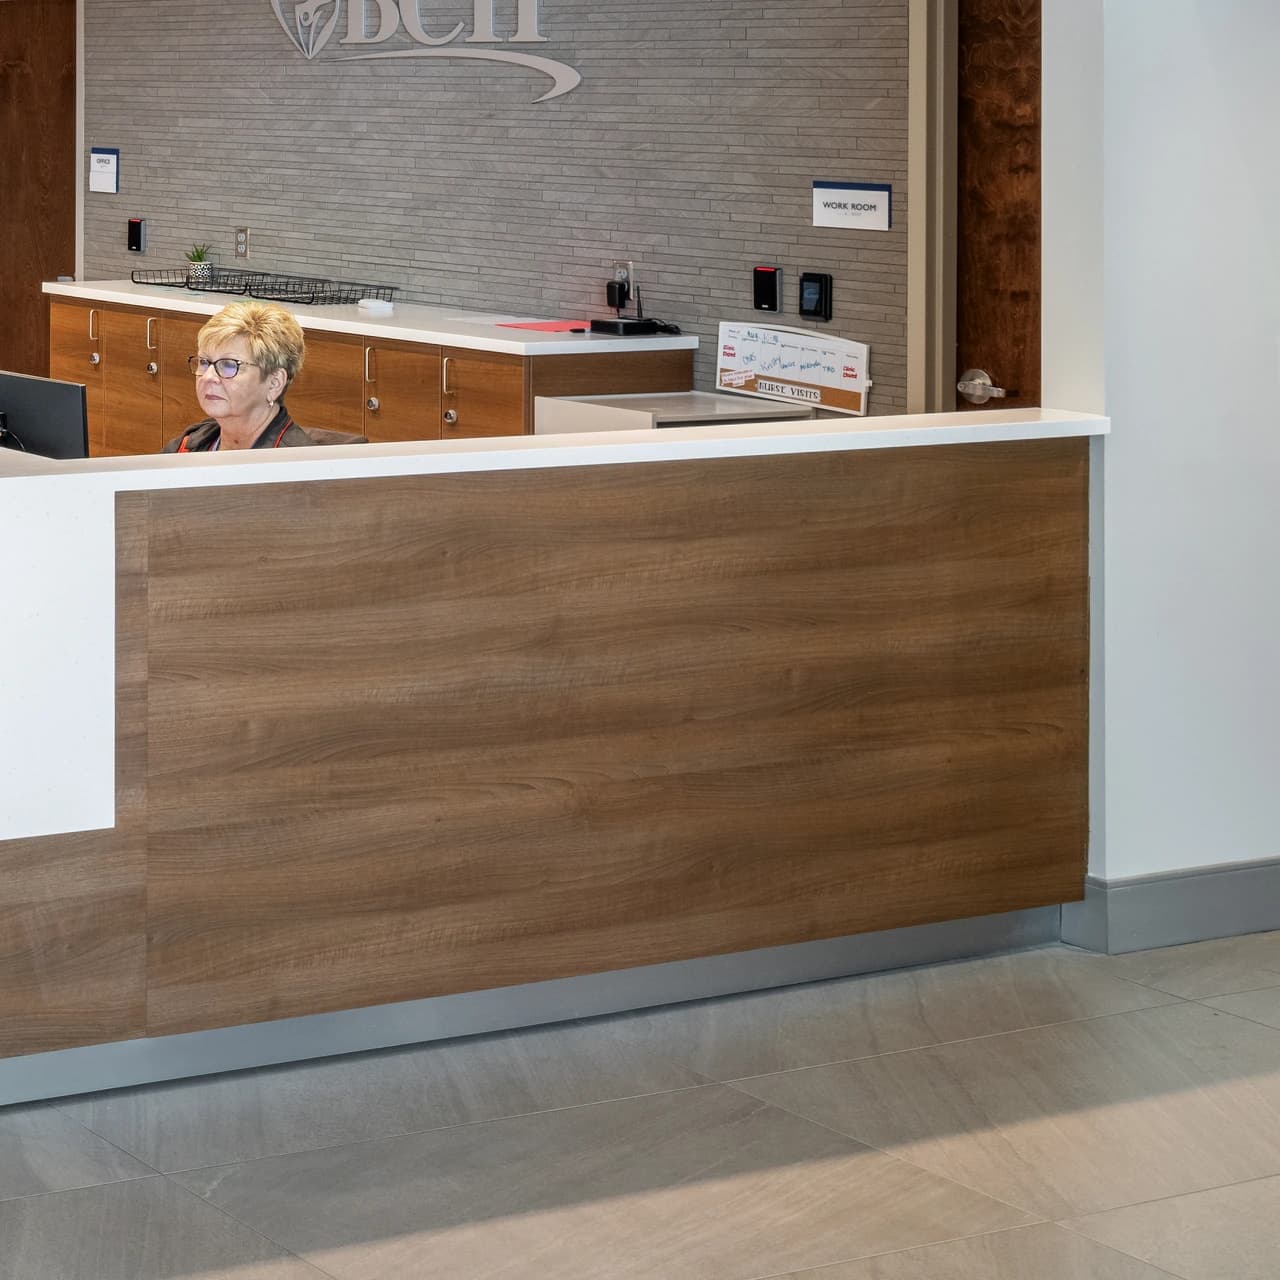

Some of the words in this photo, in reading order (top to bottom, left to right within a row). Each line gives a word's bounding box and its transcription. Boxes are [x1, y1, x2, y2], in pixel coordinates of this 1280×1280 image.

[822, 201, 848, 210] WORK
[850, 202, 877, 211] ROOM
[759, 382, 786, 394] NURSE
[790, 388, 819, 400] VISITS
